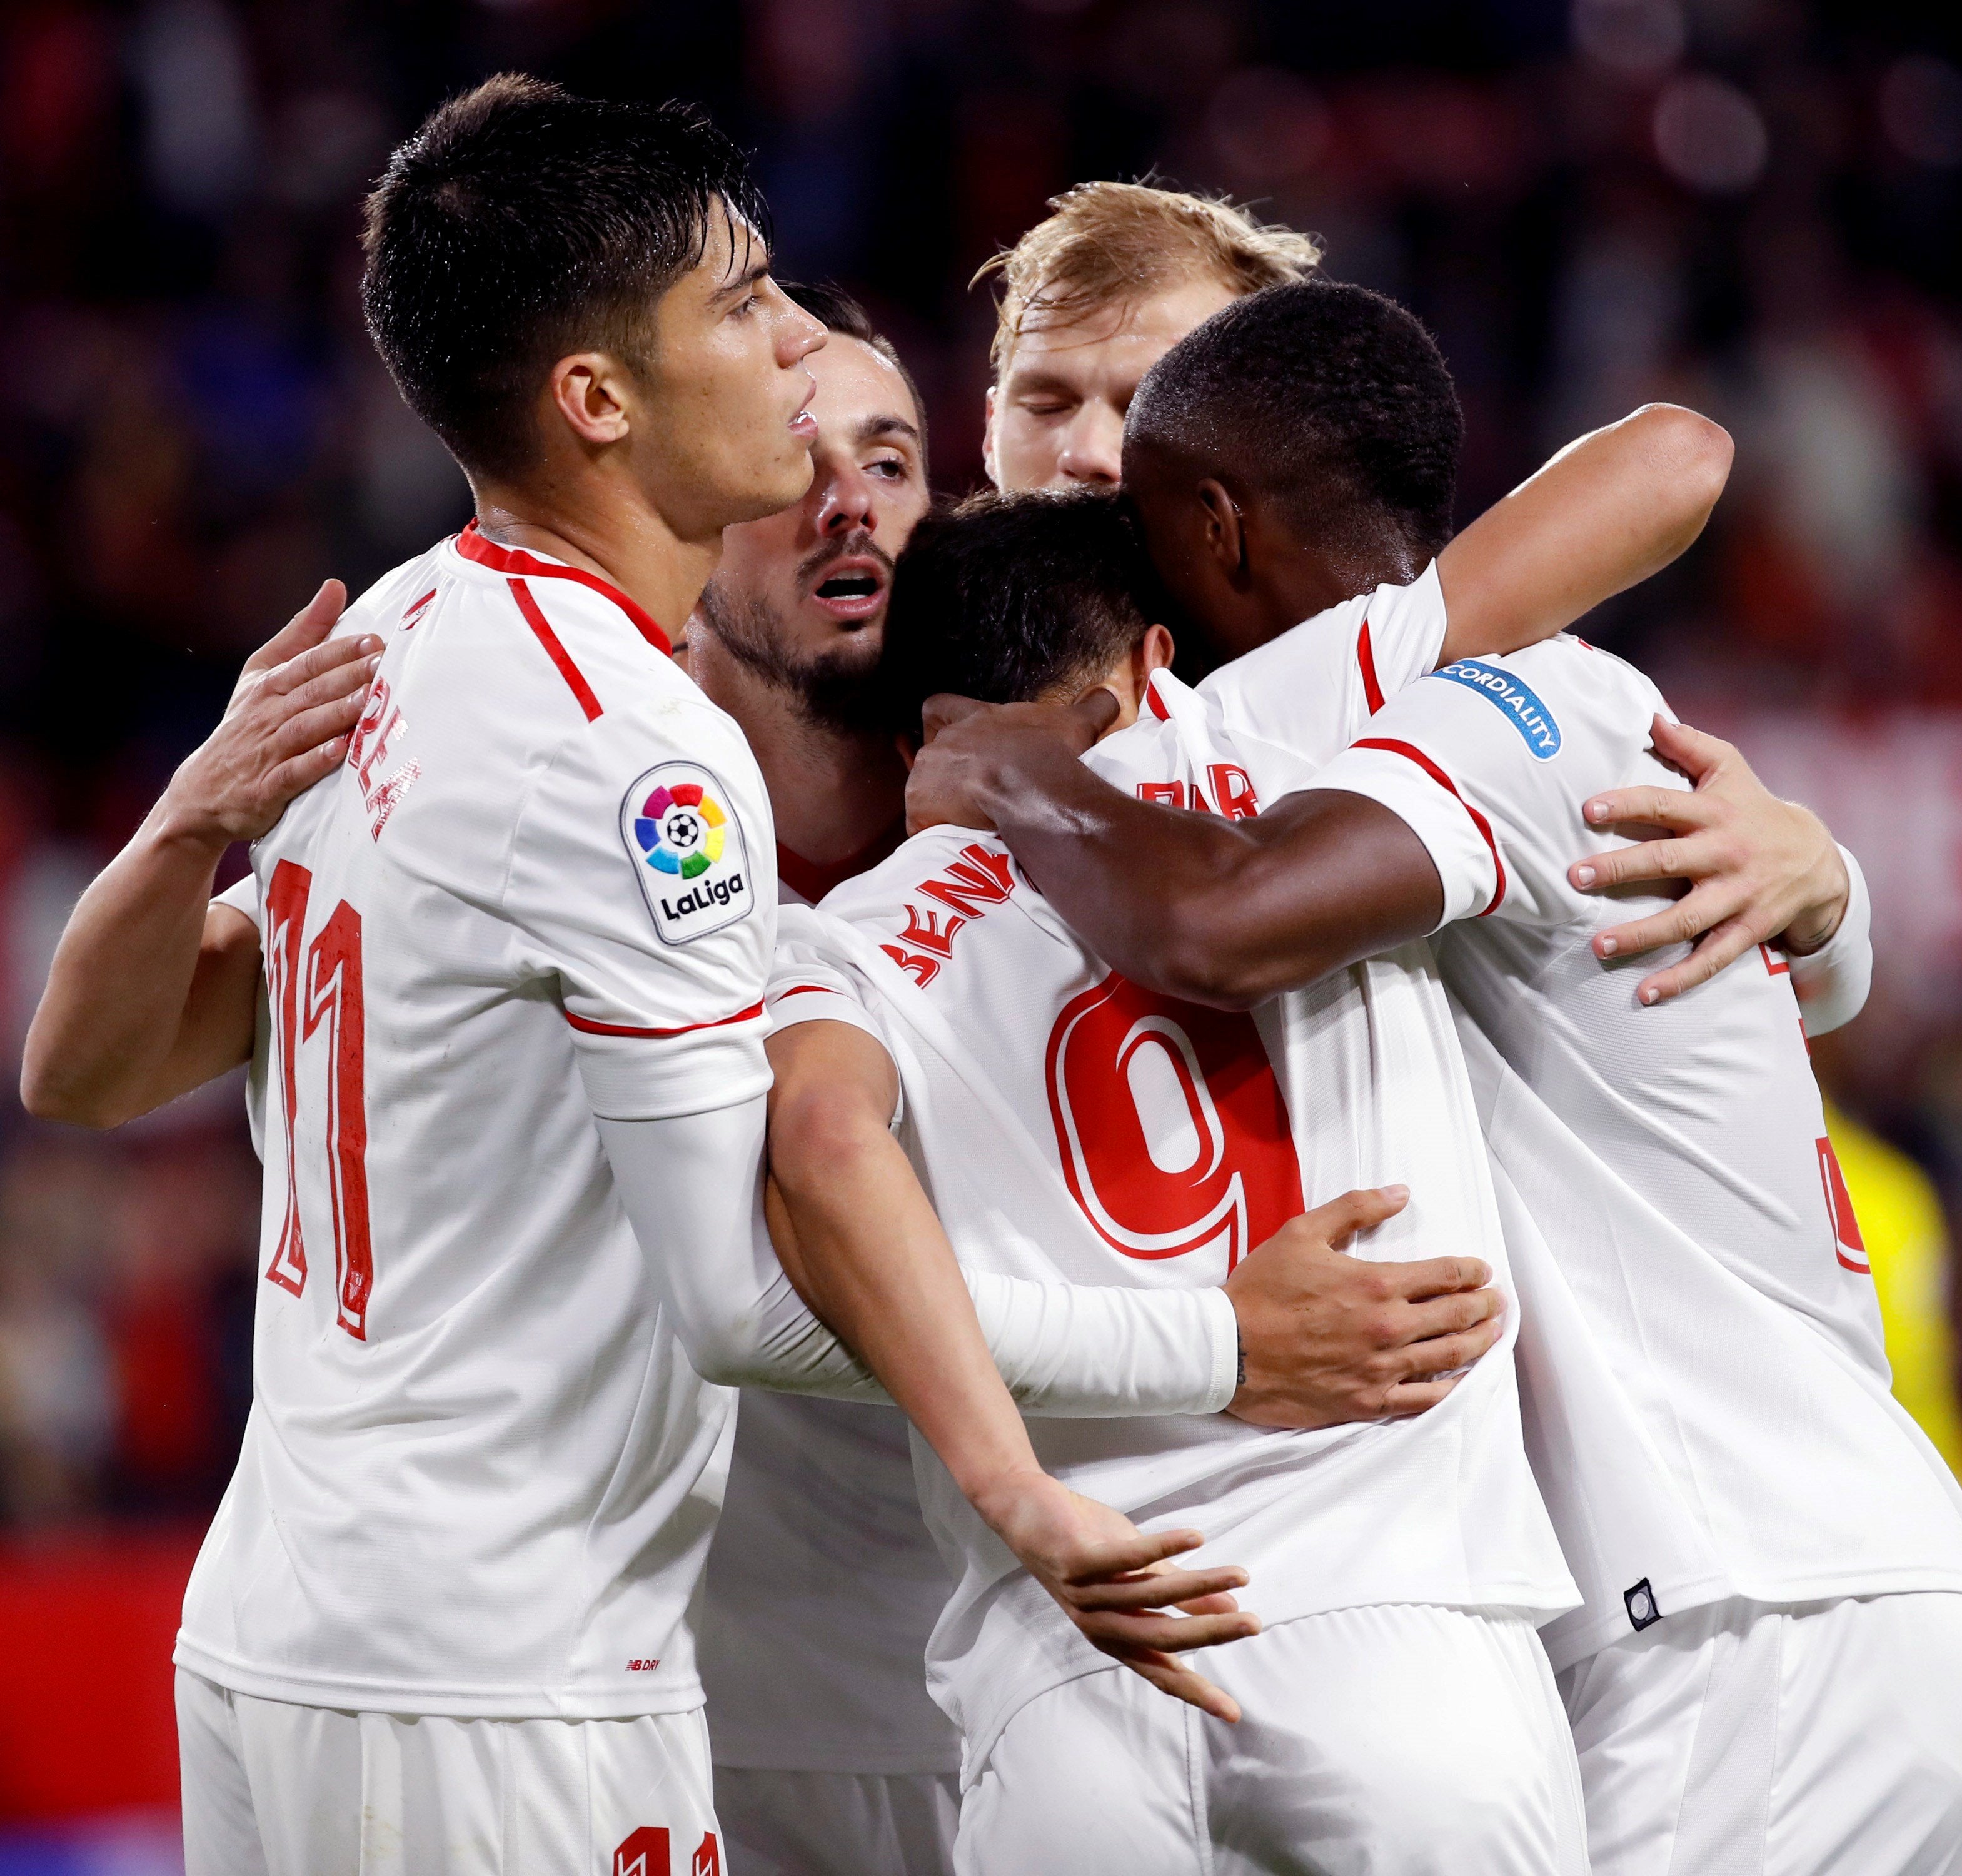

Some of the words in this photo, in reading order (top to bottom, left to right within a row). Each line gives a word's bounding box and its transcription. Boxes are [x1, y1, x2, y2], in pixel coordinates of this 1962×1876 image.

[1442, 663, 1556, 747] CORDIALITY
[660, 873, 744, 920] LaLiga
[265, 857, 372, 1342] 11
[1045, 969, 1306, 1283] 9
[641, 1659, 661, 1671] DRY
